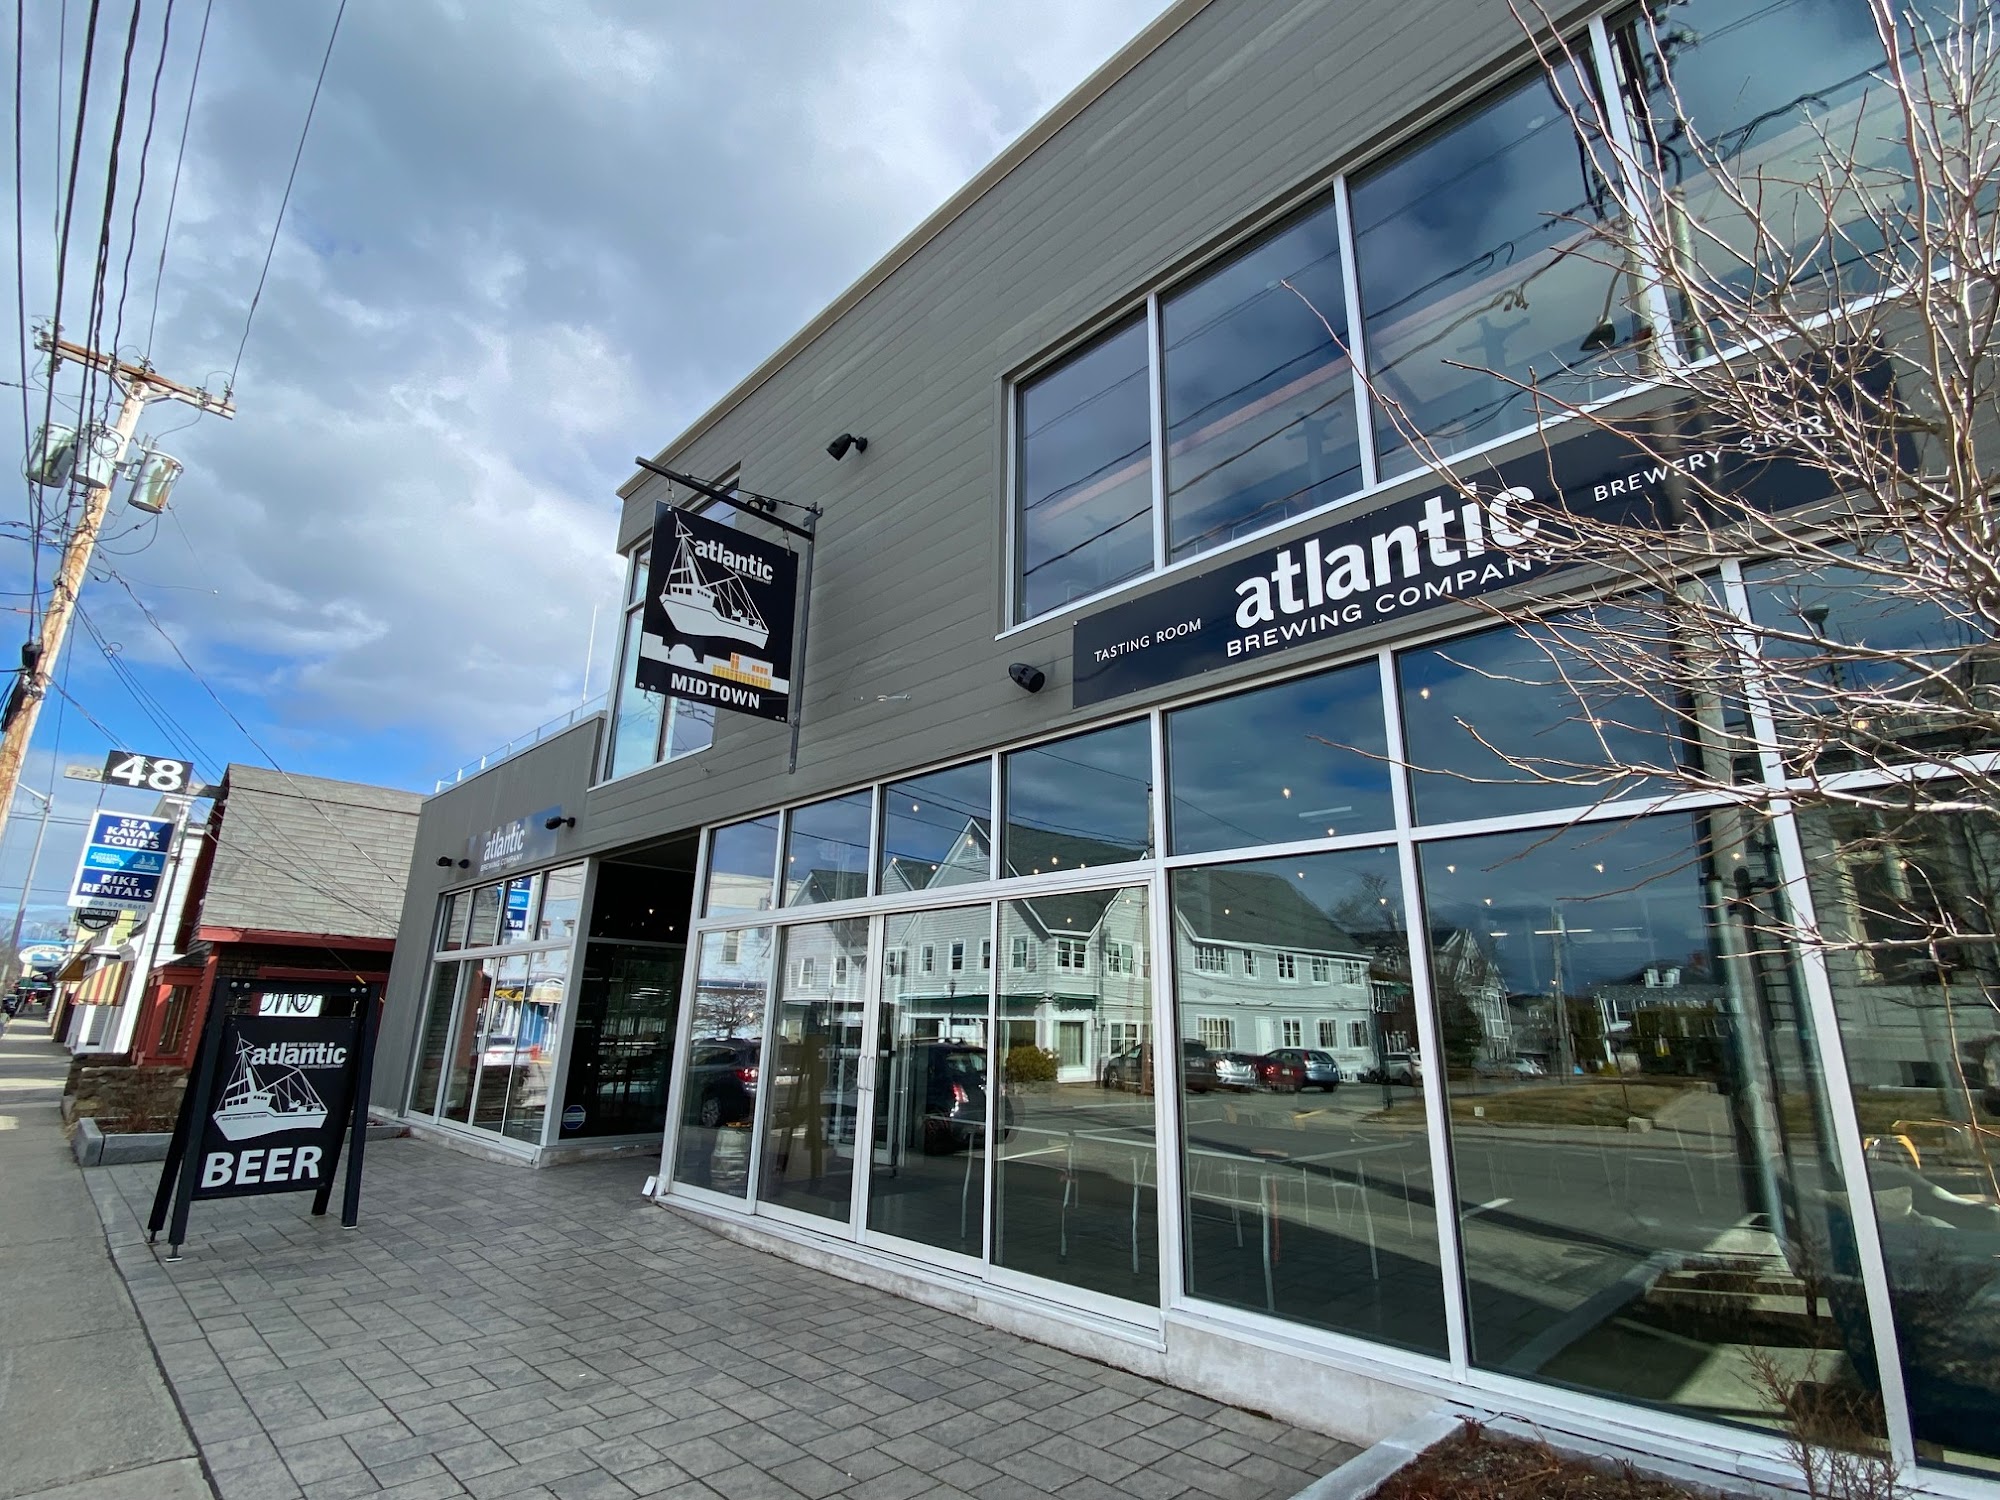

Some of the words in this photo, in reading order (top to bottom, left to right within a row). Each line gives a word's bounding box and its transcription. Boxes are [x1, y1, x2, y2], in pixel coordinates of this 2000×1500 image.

[1593, 446, 1724, 502] BREWERY
[694, 539, 774, 581] atlantic
[1235, 481, 1540, 629] atlantic
[1226, 603, 1362, 658] BREWING
[1375, 548, 1556, 614] COMPANY
[1093, 635, 1150, 663] TASTING
[1156, 617, 1202, 643] ROOM
[670, 672, 760, 710] MIDTOWN
[111, 755, 184, 791] 48
[103, 834, 160, 849] TOURS
[106, 826, 160, 841] KAYAK
[120, 818, 151, 831] SEA
[483, 823, 526, 862] atlantic
[100, 874, 139, 887] BIKE
[480, 859, 501, 872] BREWING
[500, 852, 524, 866] COMPANY
[80, 882, 153, 898] RENTALS
[251, 1042, 347, 1066] atlantic
[200, 1145, 323, 1189] BEER
